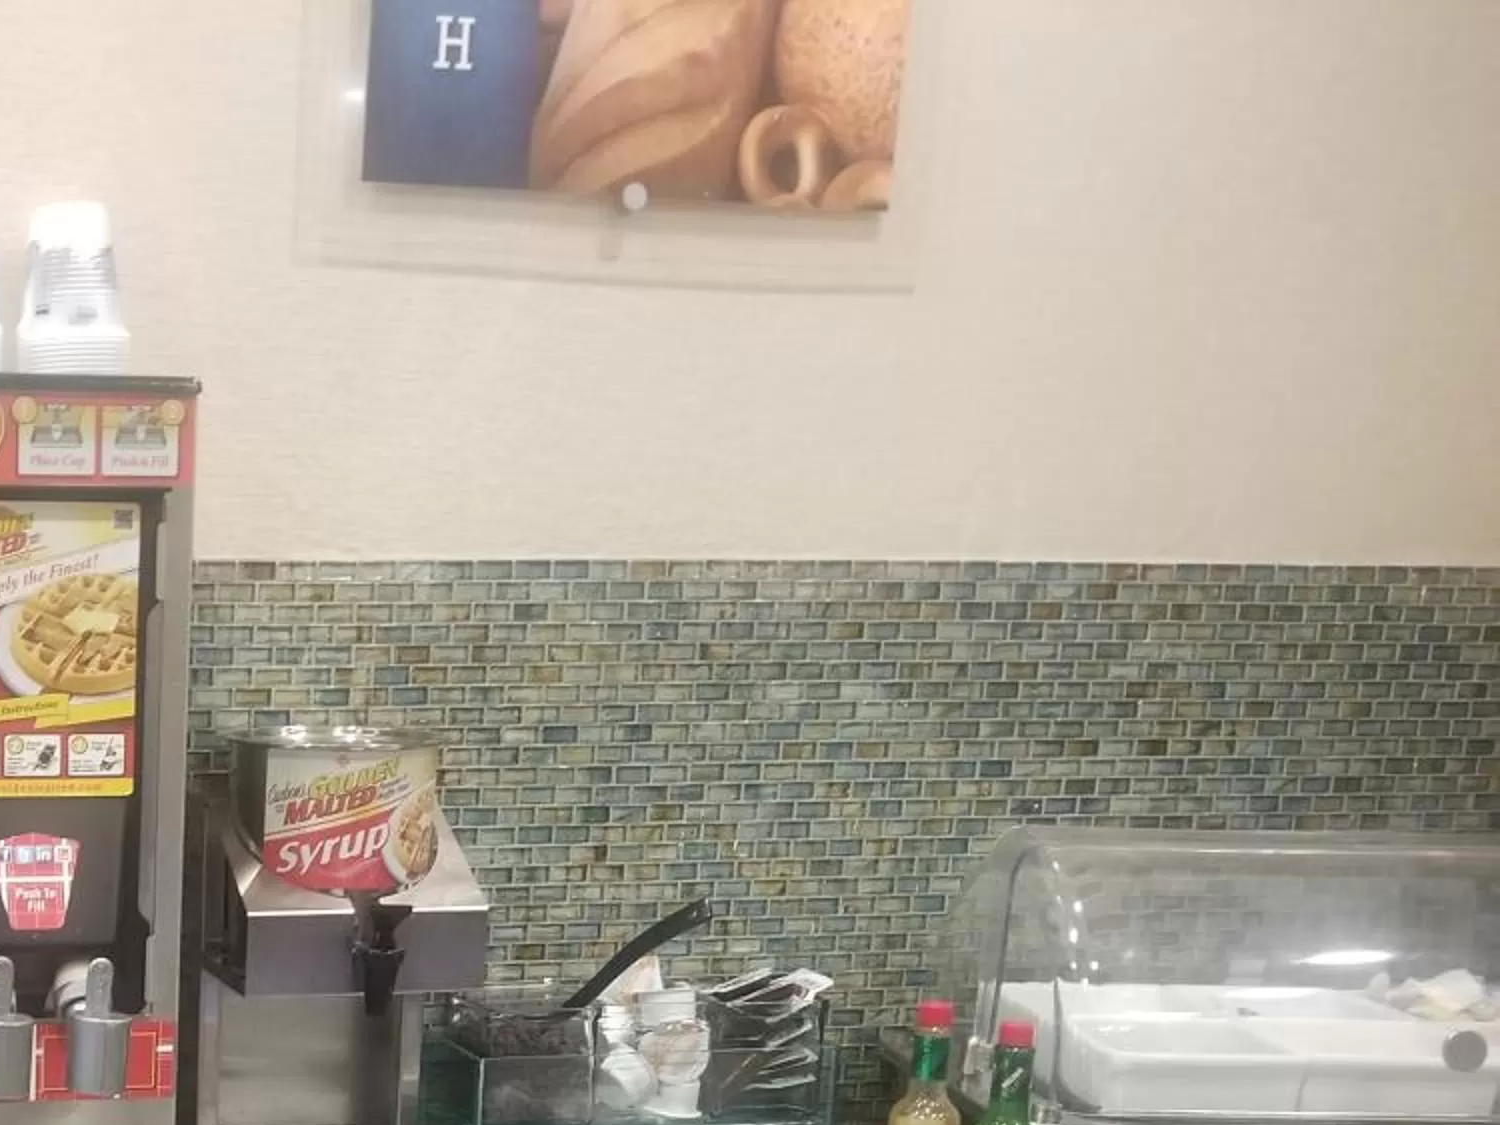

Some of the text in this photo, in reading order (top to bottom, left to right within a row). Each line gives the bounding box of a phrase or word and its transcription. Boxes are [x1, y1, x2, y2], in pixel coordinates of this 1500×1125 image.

[433, 15, 476, 71] H
[23, 568, 45, 585] the
[284, 785, 378, 826] MALTED
[276, 823, 389, 876] Syrup
